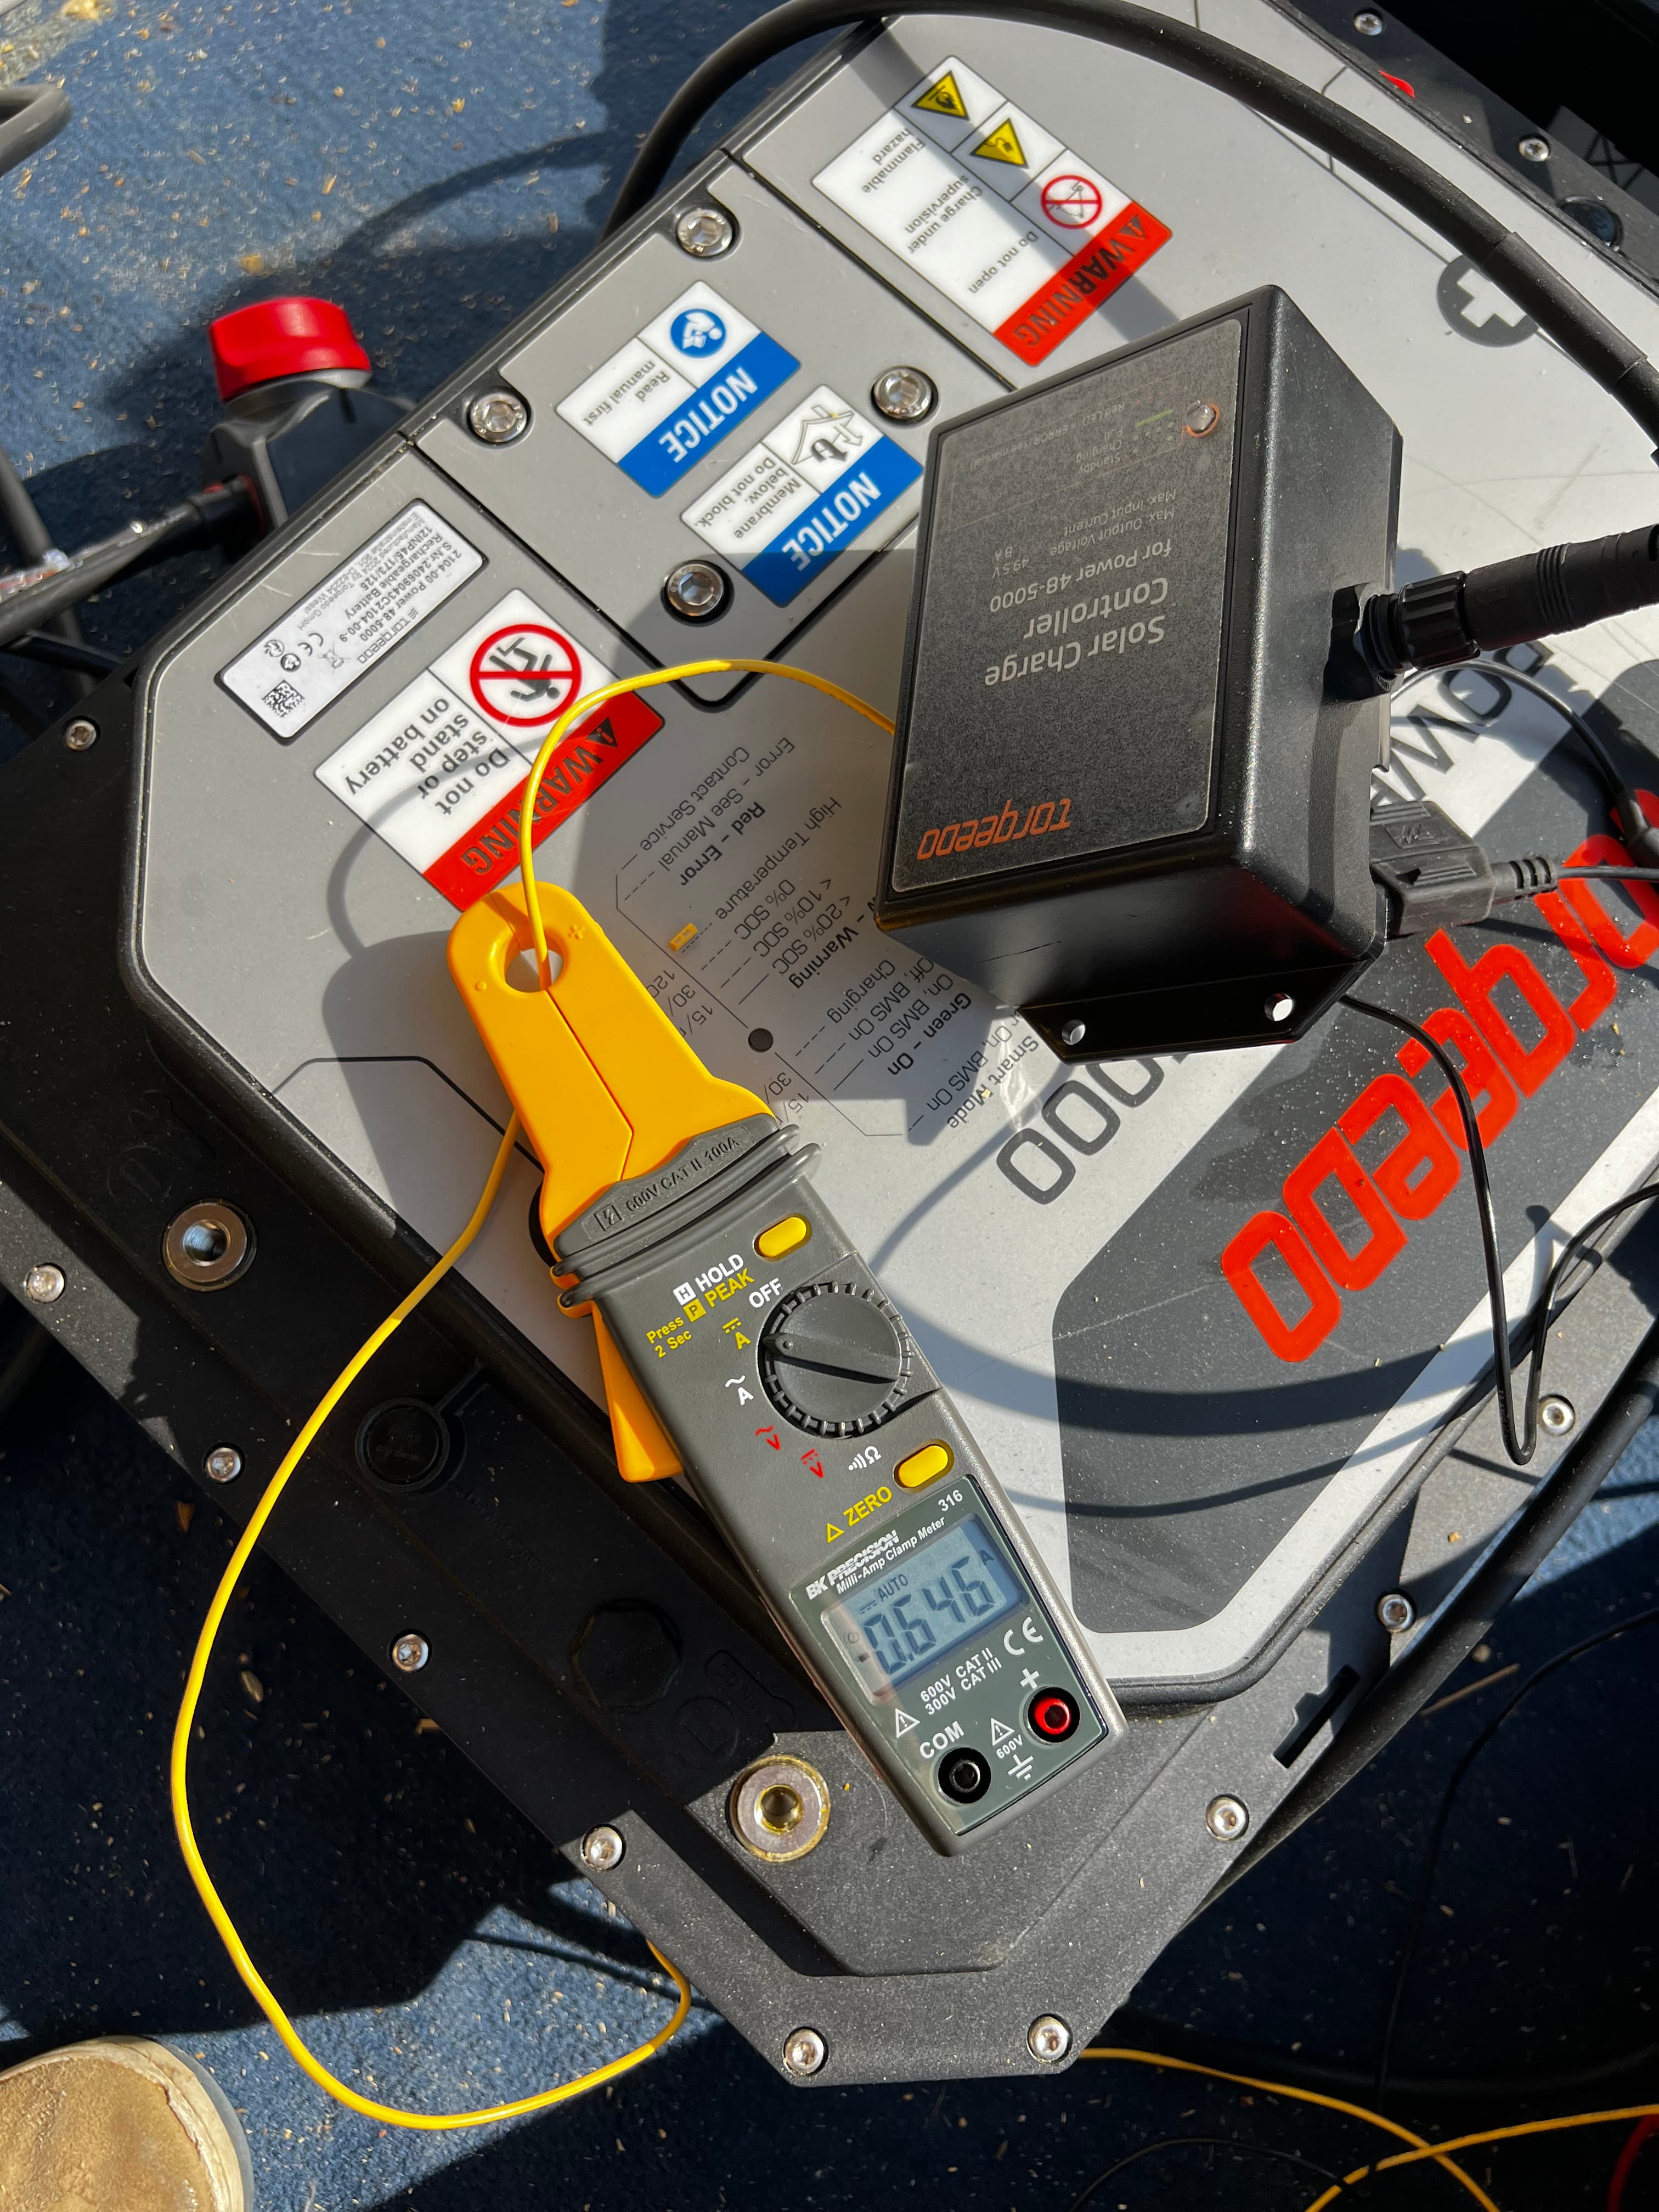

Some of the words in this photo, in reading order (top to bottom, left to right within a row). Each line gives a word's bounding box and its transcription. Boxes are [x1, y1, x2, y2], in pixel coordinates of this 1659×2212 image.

[872, 128, 913, 165] hazard
[861, 138, 926, 193] Flammable
[905, 176, 969, 234] supervision
[940, 187, 983, 222] Charge
[907, 222, 941, 253] under
[1019, 231, 1039, 247] Do
[1002, 249, 1019, 268] not
[968, 266, 998, 294] open
[1013, 238, 1136, 346] WARNING
[609, 361, 656, 405] manual
[635, 371, 669, 402] Read
[584, 402, 613, 426] first
[658, 367, 758, 463] NOTICE
[1104, 427, 1122, 441] Full
[756, 456, 776, 475] Do
[1076, 440, 1121, 463] Charging
[1078, 453, 1120, 474] Standby
[733, 473, 754, 496] not
[744, 467, 789, 504] below.
[1148, 489, 1177, 506] Max.
[694, 493, 735, 528] block.
[735, 478, 801, 539] Membrane
[781, 472, 882, 571] NOTICE
[1064, 511, 1108, 535] Current
[1111, 496, 1144, 519] Input
[1147, 505, 1175, 522] Max.
[1050, 534, 1095, 556] Voltage
[1098, 518, 1142, 543] Output
[380, 534, 443, 589] Rechargeable
[425, 549, 461, 583] 2104-00
[995, 549, 1001, 561] A
[1003, 557, 1029, 575] 49.5
[1005, 546, 1013, 558] 8
[1076, 550, 1137, 582] Power
[1142, 539, 1172, 560] for
[992, 567, 1000, 579] V
[345, 589, 381, 619] Battery
[397, 582, 426, 609] Power
[990, 574, 1071, 612] 48-5000
[1024, 578, 1168, 639] Controller
[360, 609, 396, 641] 48-5000
[1088, 616, 1165, 657] Solar
[985, 642, 1081, 686] Charge
[420, 698, 449, 724] on
[345, 724, 426, 796] battery
[410, 716, 469, 774] stand
[442, 731, 488, 776] step
[755, 738, 795, 776] Error
[475, 748, 511, 777] Do
[691, 747, 749, 802] Contact
[417, 775, 440, 800] or
[435, 777, 474, 816] not
[712, 788, 743, 816] See
[640, 800, 696, 850] Service
[731, 802, 766, 835] Red
[804, 797, 842, 830] High
[658, 816, 715, 871] Manual
[680, 845, 723, 885] Error
[715, 832, 810, 919] Temperature
[765, 880, 795, 907] 0%
[785, 890, 821, 924] 10%
[734, 905, 770, 940] SOC
[753, 922, 789, 957] SOC
[803, 904, 842, 941] 20%
[772, 939, 808, 974] SOC
[789, 927, 859, 989] Warning
[905, 956, 934, 983] Off,
[827, 960, 895, 1023] Charging
[871, 981, 910, 1021] BMS
[923, 974, 953, 996] On,
[849, 1019, 874, 1040] On
[890, 999, 929, 1039] BMS
[923, 992, 971, 1038] Green
[868, 1036, 894, 1058] On
[982, 1026, 1012, 1047] On,
[888, 1053, 914, 1075] On
[949, 1051, 989, 1091] BMS
[989, 1035, 1039, 1085] Smart
[927, 1088, 953, 1110] On
[947, 1084, 994, 1128] Mode
[625, 1184, 661, 1211] 600V
[661, 1168, 690, 1189] CAT
[705, 1137, 739, 1161] 100A
[695, 1254, 744, 1292] HOLD
[704, 1268, 754, 1308] PEAK
[749, 1278, 783, 1308] OFF
[646, 1317, 684, 1344] Press
[654, 1345, 666, 1358] 2
[667, 1330, 692, 1350] Sec
[735, 1331, 751, 1350] A
[737, 1386, 754, 1406] A
[843, 1486, 893, 1527] ZERO
[938, 1489, 963, 1512] 316
[805, 1576, 829, 1600] BK
[827, 1530, 899, 1585] PRECISION
[836, 1556, 886, 1594] Milli-Amp
[885, 1534, 918, 1561] Clamp
[917, 1516, 945, 1540] Meter
[878, 1573, 909, 1603] AUTO
[864, 1556, 994, 1675] 0.646
[919, 1674, 952, 1703] 600V
[955, 1654, 982, 1679] CAT
[984, 1646, 994, 1661] II
[924, 1687, 957, 1716] 300V
[960, 1667, 987, 1692] CAT
[986, 1658, 1002, 1674] III
[919, 1720, 965, 1759] COM
[996, 1734, 1024, 1759] 600V
